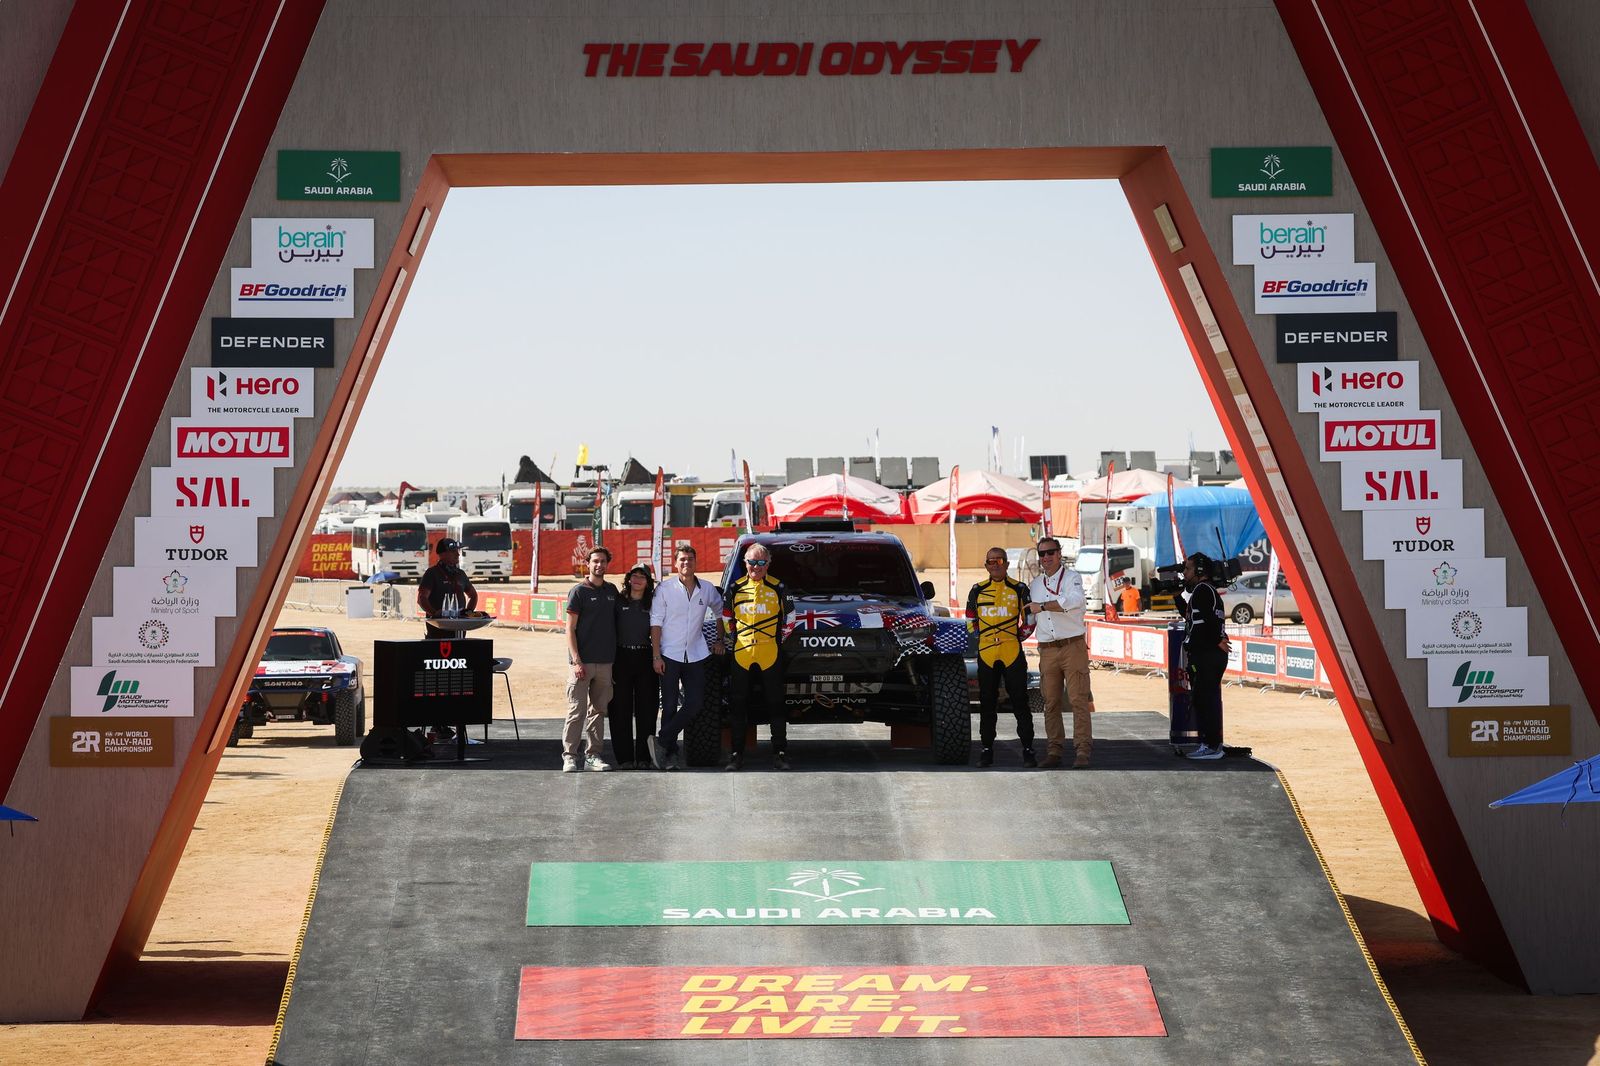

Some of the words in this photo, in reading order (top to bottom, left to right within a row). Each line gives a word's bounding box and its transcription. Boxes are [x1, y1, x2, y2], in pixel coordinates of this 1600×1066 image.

[583, 43, 669, 77] THE
[669, 42, 813, 77] SAUDI
[818, 38, 1042, 76] ODYSSEY
[304, 186, 334, 195] SAUDI
[336, 186, 374, 196] ARABIA
[1238, 182, 1267, 191] SAUDI
[1269, 182, 1307, 191] ARABIA
[278, 249, 344, 263] بيرين
[1260, 244, 1325, 259] بيرين
[239, 284, 347, 297] BFGoodrich
[1262, 279, 1368, 294] BFGoodrich
[220, 336, 325, 349] DEFENDER
[1284, 331, 1389, 344] DEFENDER
[182, 431, 286, 454] MOTUL
[1330, 424, 1431, 448] MOTUL
[1393, 539, 1455, 552] TUDOR
[165, 548, 229, 561] TUDOR
[312, 552, 346, 562] DARE.
[312, 562, 337, 571] LIVE
[1421, 589, 1448, 598] الرياضة
[1450, 589, 1470, 598] وزارة
[151, 597, 178, 606] الرياضة
[180, 597, 200, 606] وزارة
[739, 603, 771, 615] RCM.
[980, 606, 1013, 617] RCM.
[800, 636, 856, 648] TOYOTA
[423, 658, 468, 670] TUDOR
[1247, 651, 1276, 665] DEFENDER
[1287, 655, 1315, 669] DEFENDER
[1503, 726, 1550, 734] RALLY-RAID
[105, 738, 152, 746] RALLY-RAID
[662, 908, 802, 919] SAUDI
[815, 907, 997, 919] ARABIA
[680, 974, 988, 993] DREAM.
[680, 994, 919, 1013] DARE.
[680, 1015, 861, 1035] LIVE
[877, 1015, 968, 1034] IT.
